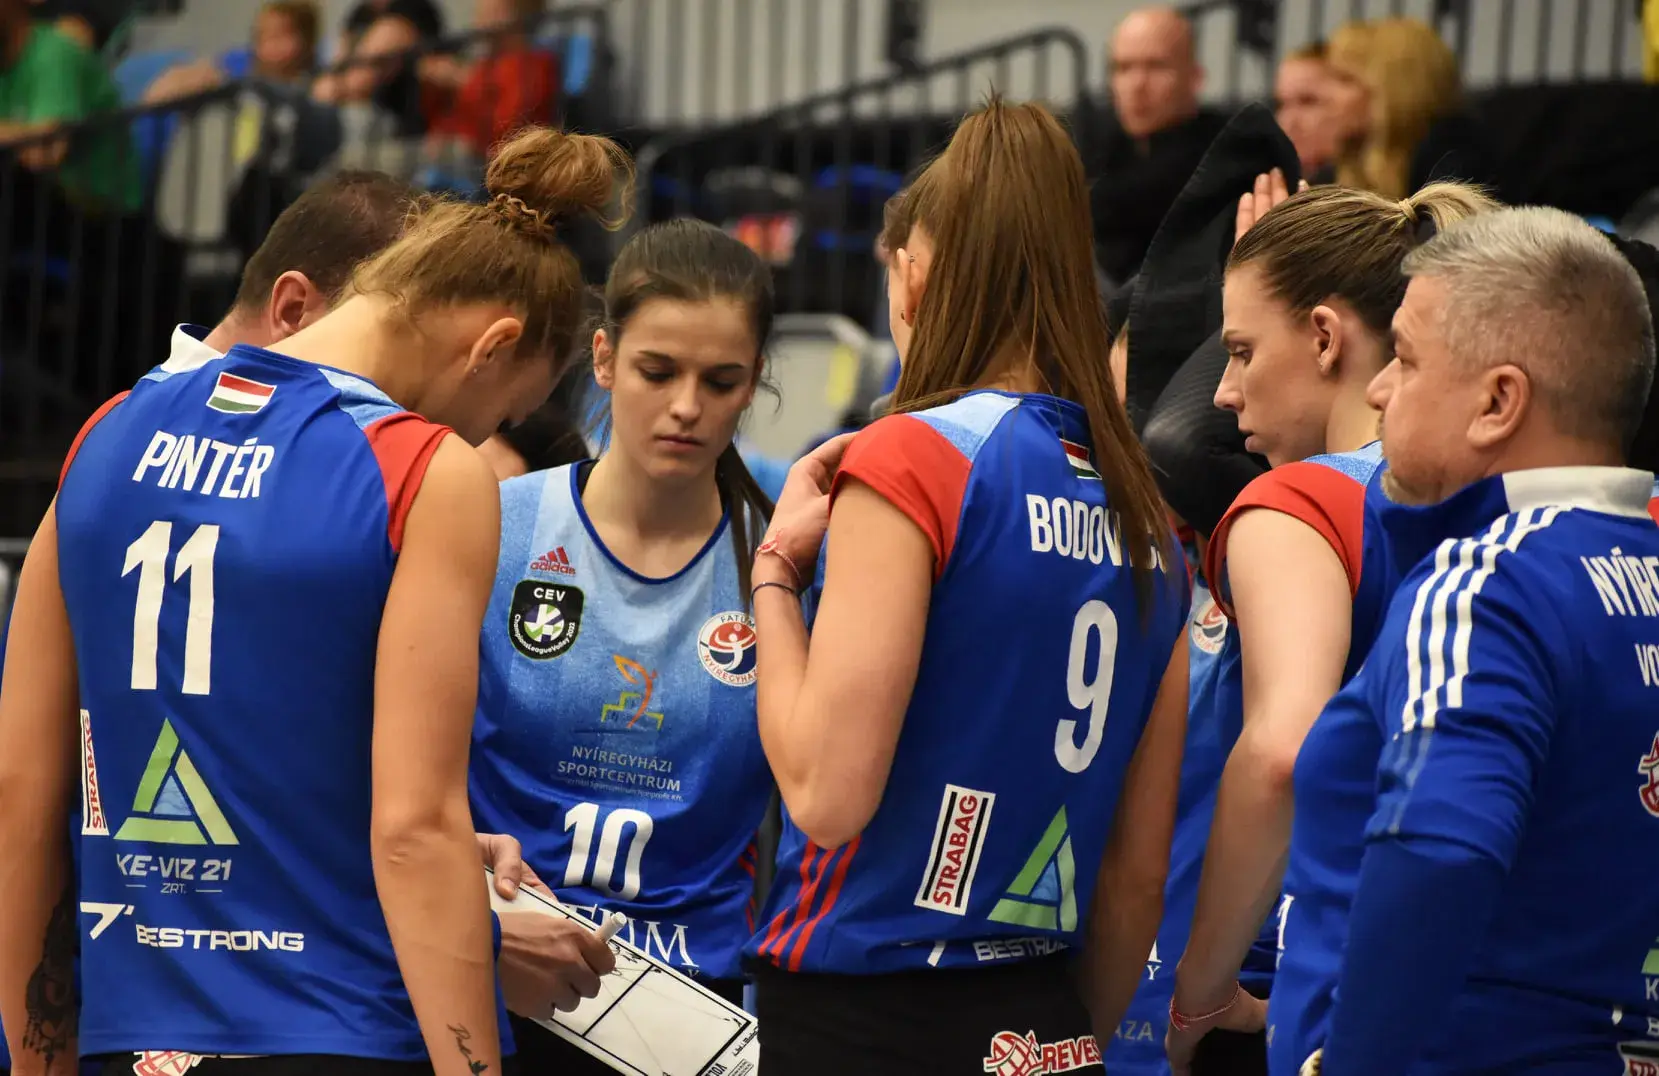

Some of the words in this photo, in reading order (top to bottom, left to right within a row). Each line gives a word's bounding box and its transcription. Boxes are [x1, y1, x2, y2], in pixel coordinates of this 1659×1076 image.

[132, 430, 275, 499] PINTÉR
[1026, 494, 1166, 573] BODOV
[531, 560, 576, 575] adidas
[121, 520, 219, 695] 11
[533, 587, 566, 602] CEV
[1054, 599, 1118, 773] 9
[572, 745, 673, 773] NYÍREGYHÁZI
[557, 760, 681, 792] SPORTCENTRUM
[563, 802, 654, 901] 10
[932, 794, 979, 906] STRABAG
[116, 853, 196, 880] KE-VIZ
[200, 859, 233, 881] 21
[136, 924, 305, 952] BESTRONG
[973, 937, 1070, 961] BESTRO
